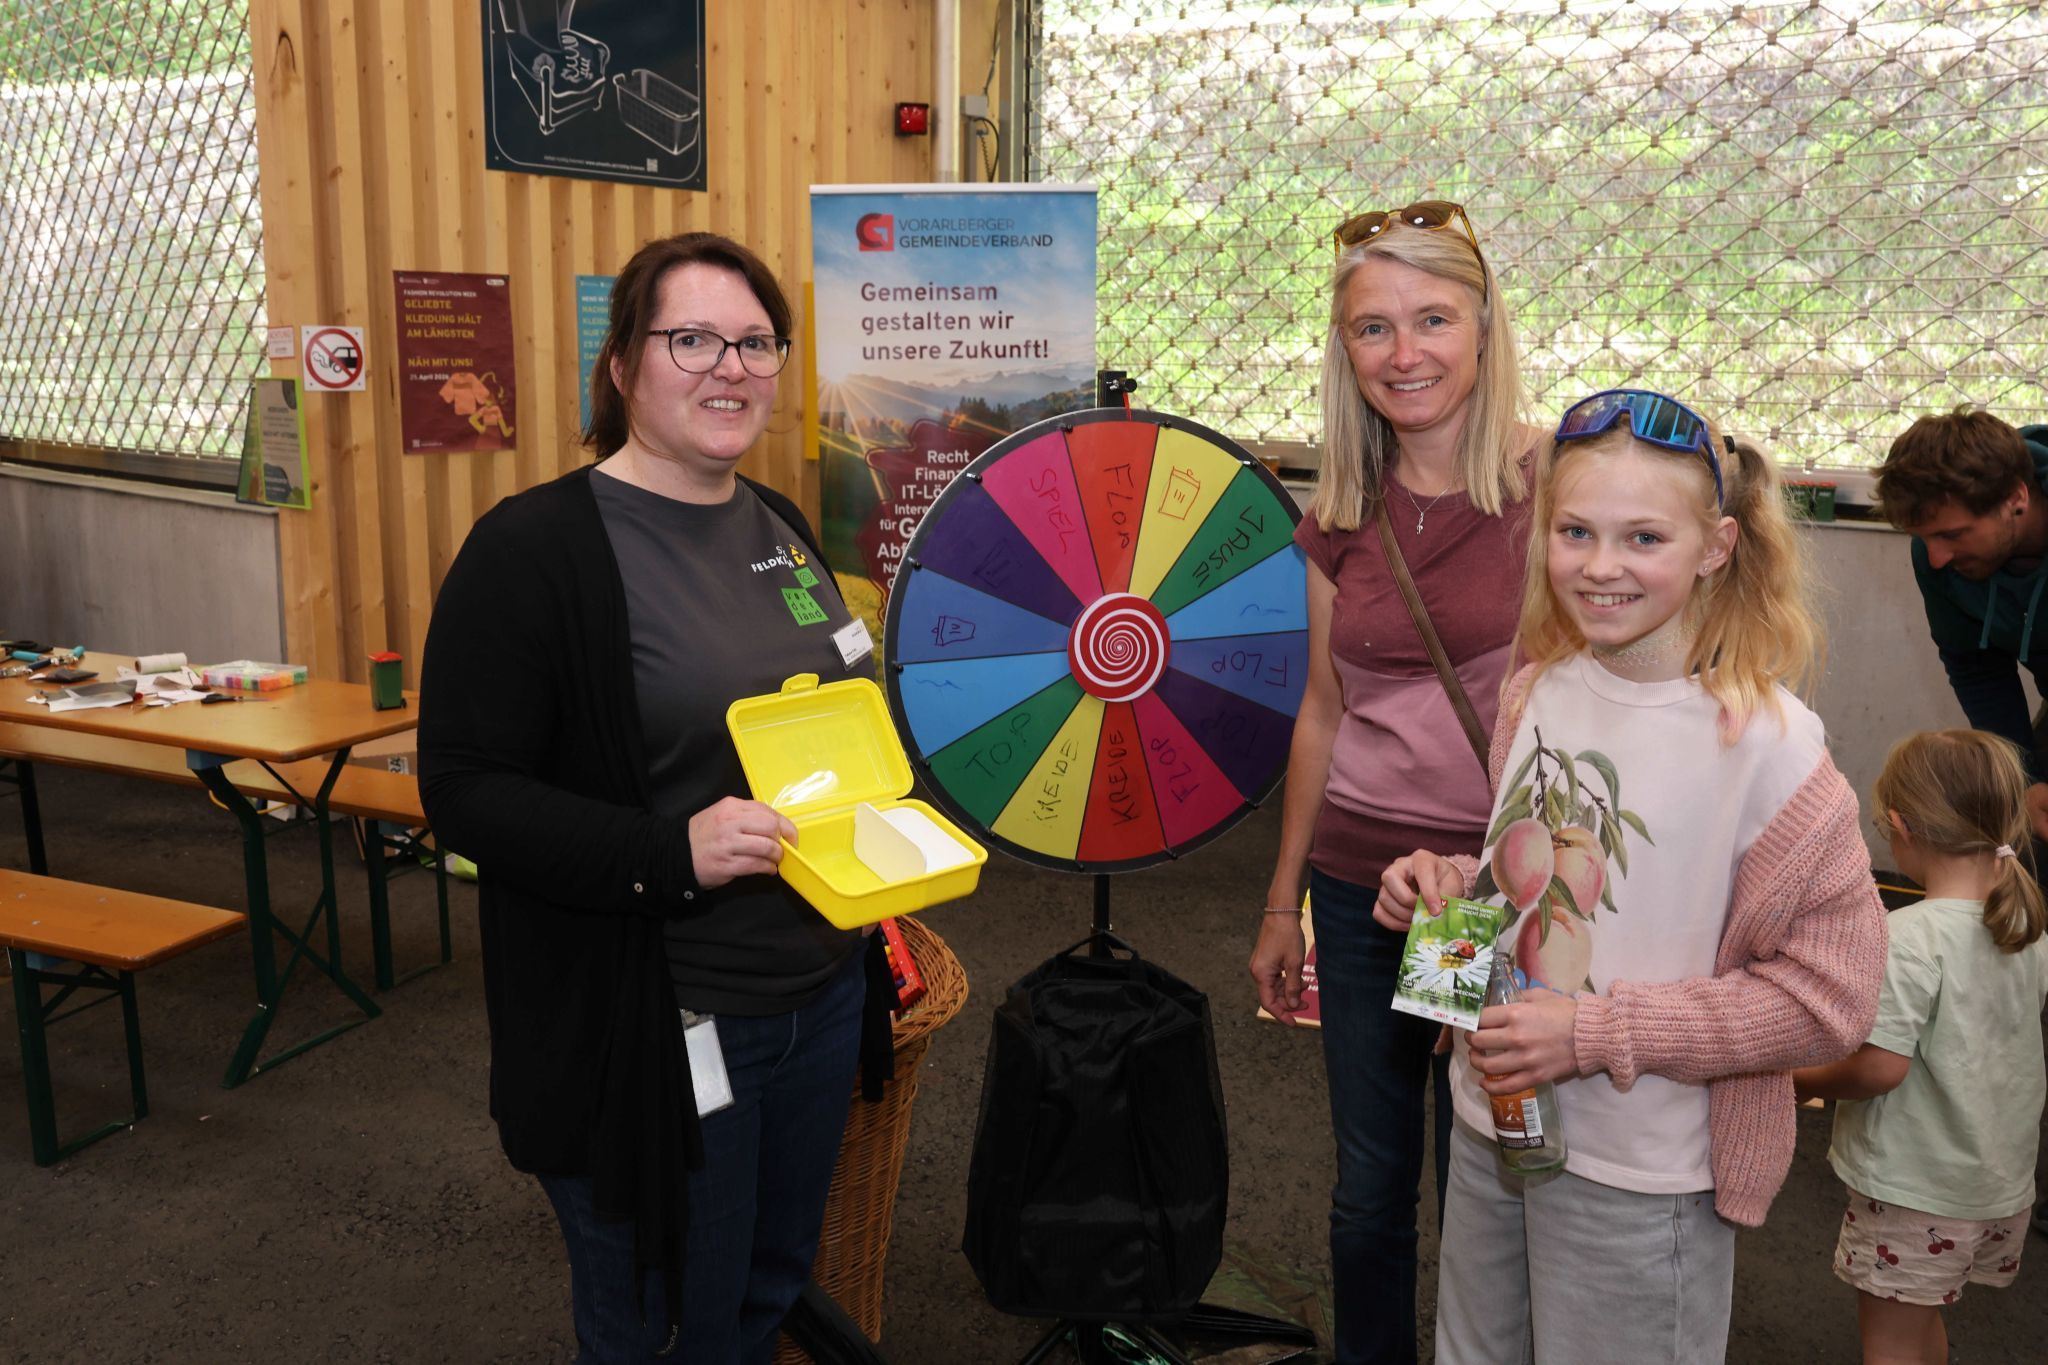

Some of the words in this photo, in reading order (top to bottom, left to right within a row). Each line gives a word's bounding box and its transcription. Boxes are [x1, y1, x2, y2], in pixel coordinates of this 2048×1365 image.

[898, 218, 1016, 231] VORARLBERGER
[899, 234, 1053, 248] GEMEINDEVERBAND
[860, 281, 998, 302] Gemeinsam
[404, 299, 452, 309] GELIEBTE
[405, 313, 456, 324] KLEIDUNG
[457, 314, 482, 325] HÄLT
[861, 312, 971, 336] gestalten
[979, 310, 1014, 330] wir
[406, 328, 421, 338] AM
[423, 327, 475, 339] LÄNGSTEN
[862, 344, 942, 360] unsere
[949, 339, 1049, 359] Zukunft!
[407, 356, 430, 367] NÄH
[431, 358, 449, 366] MIT
[450, 358, 474, 367] UNS!
[927, 450, 970, 463] Recht
[902, 484, 943, 500] IT-Lö
[894, 504, 929, 515] Intere
[1030, 468, 1077, 555] SPIEL
[879, 519, 897, 530] für
[1191, 505, 1265, 588] JAUSE
[799, 609, 823, 622] land
[963, 712, 1032, 779] TOP
[1108, 729, 1140, 827] KREIDE
